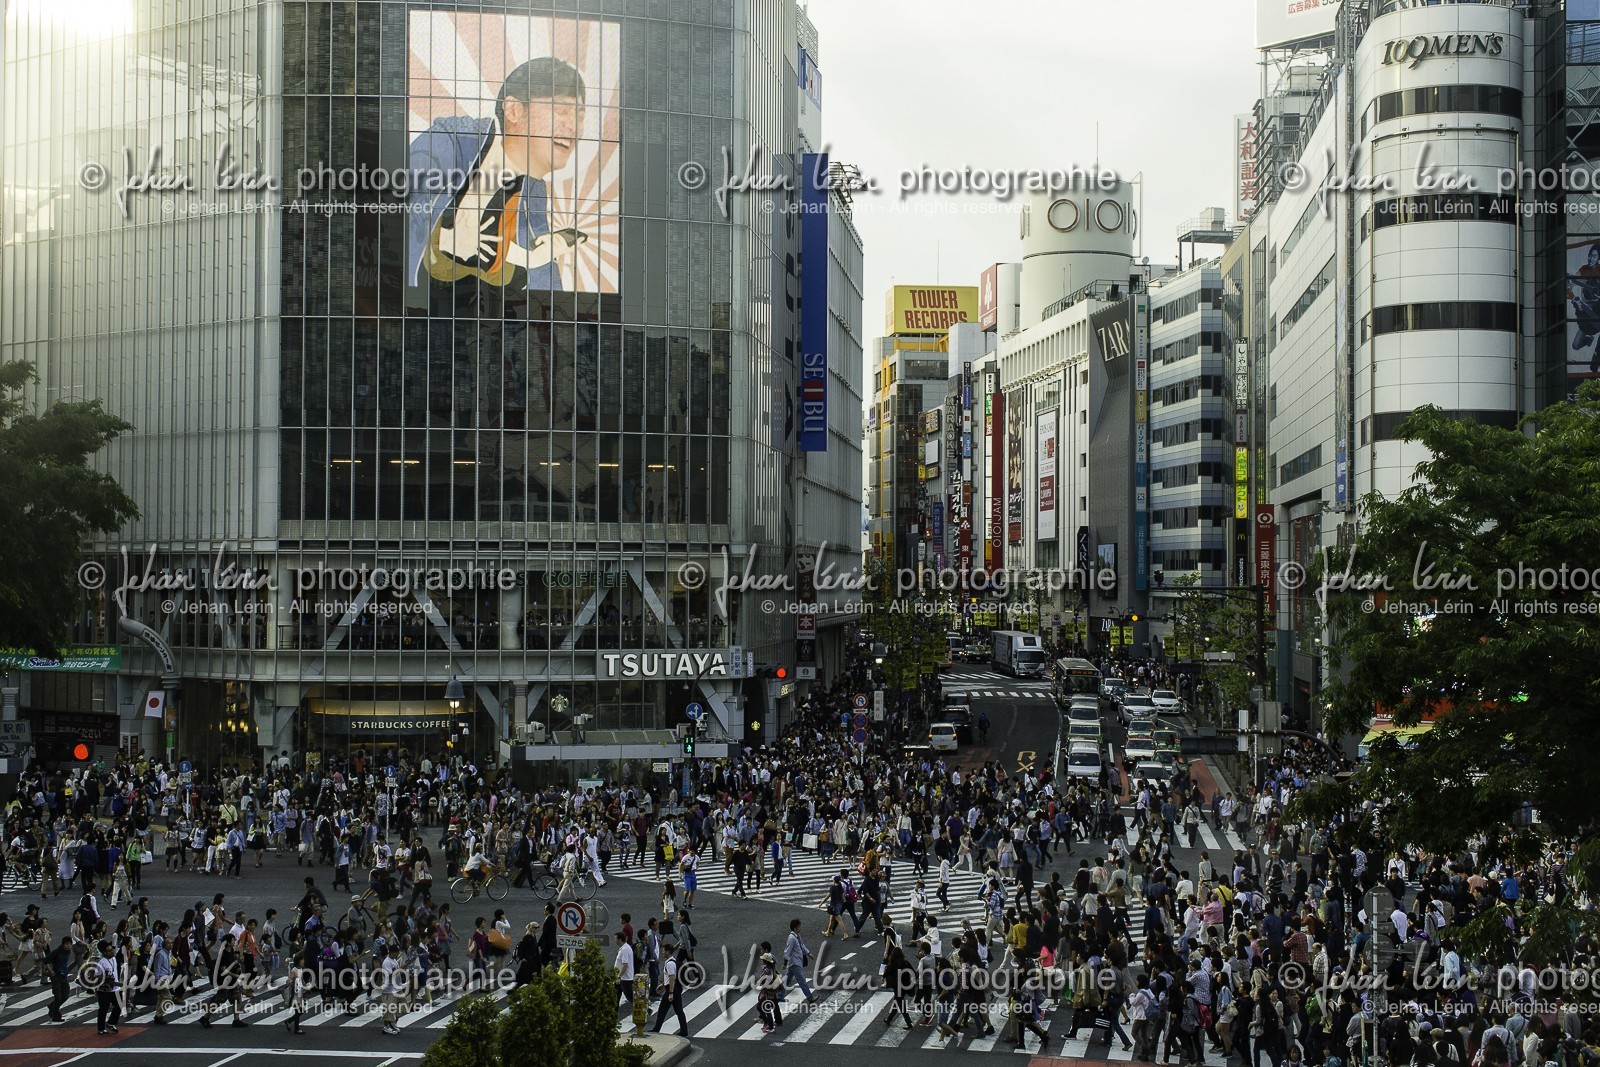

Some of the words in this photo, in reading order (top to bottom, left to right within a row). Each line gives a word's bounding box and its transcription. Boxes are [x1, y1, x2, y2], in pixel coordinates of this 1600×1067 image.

[909, 289, 959, 309] TOWER
[904, 310, 968, 330] RECORDS
[803, 353, 824, 432] SEIBU
[945, 396, 956, 459] KARAOKE
[1079, 533, 1087, 570] ZARA
[542, 571, 628, 588] COFFEE
[799, 617, 812, 630] 本
[603, 653, 727, 677] TSUTAYA
[0, 723, 26, 734] 駅前
[351, 721, 413, 729] STARBUCKS
[415, 720, 450, 729] COFFEE
